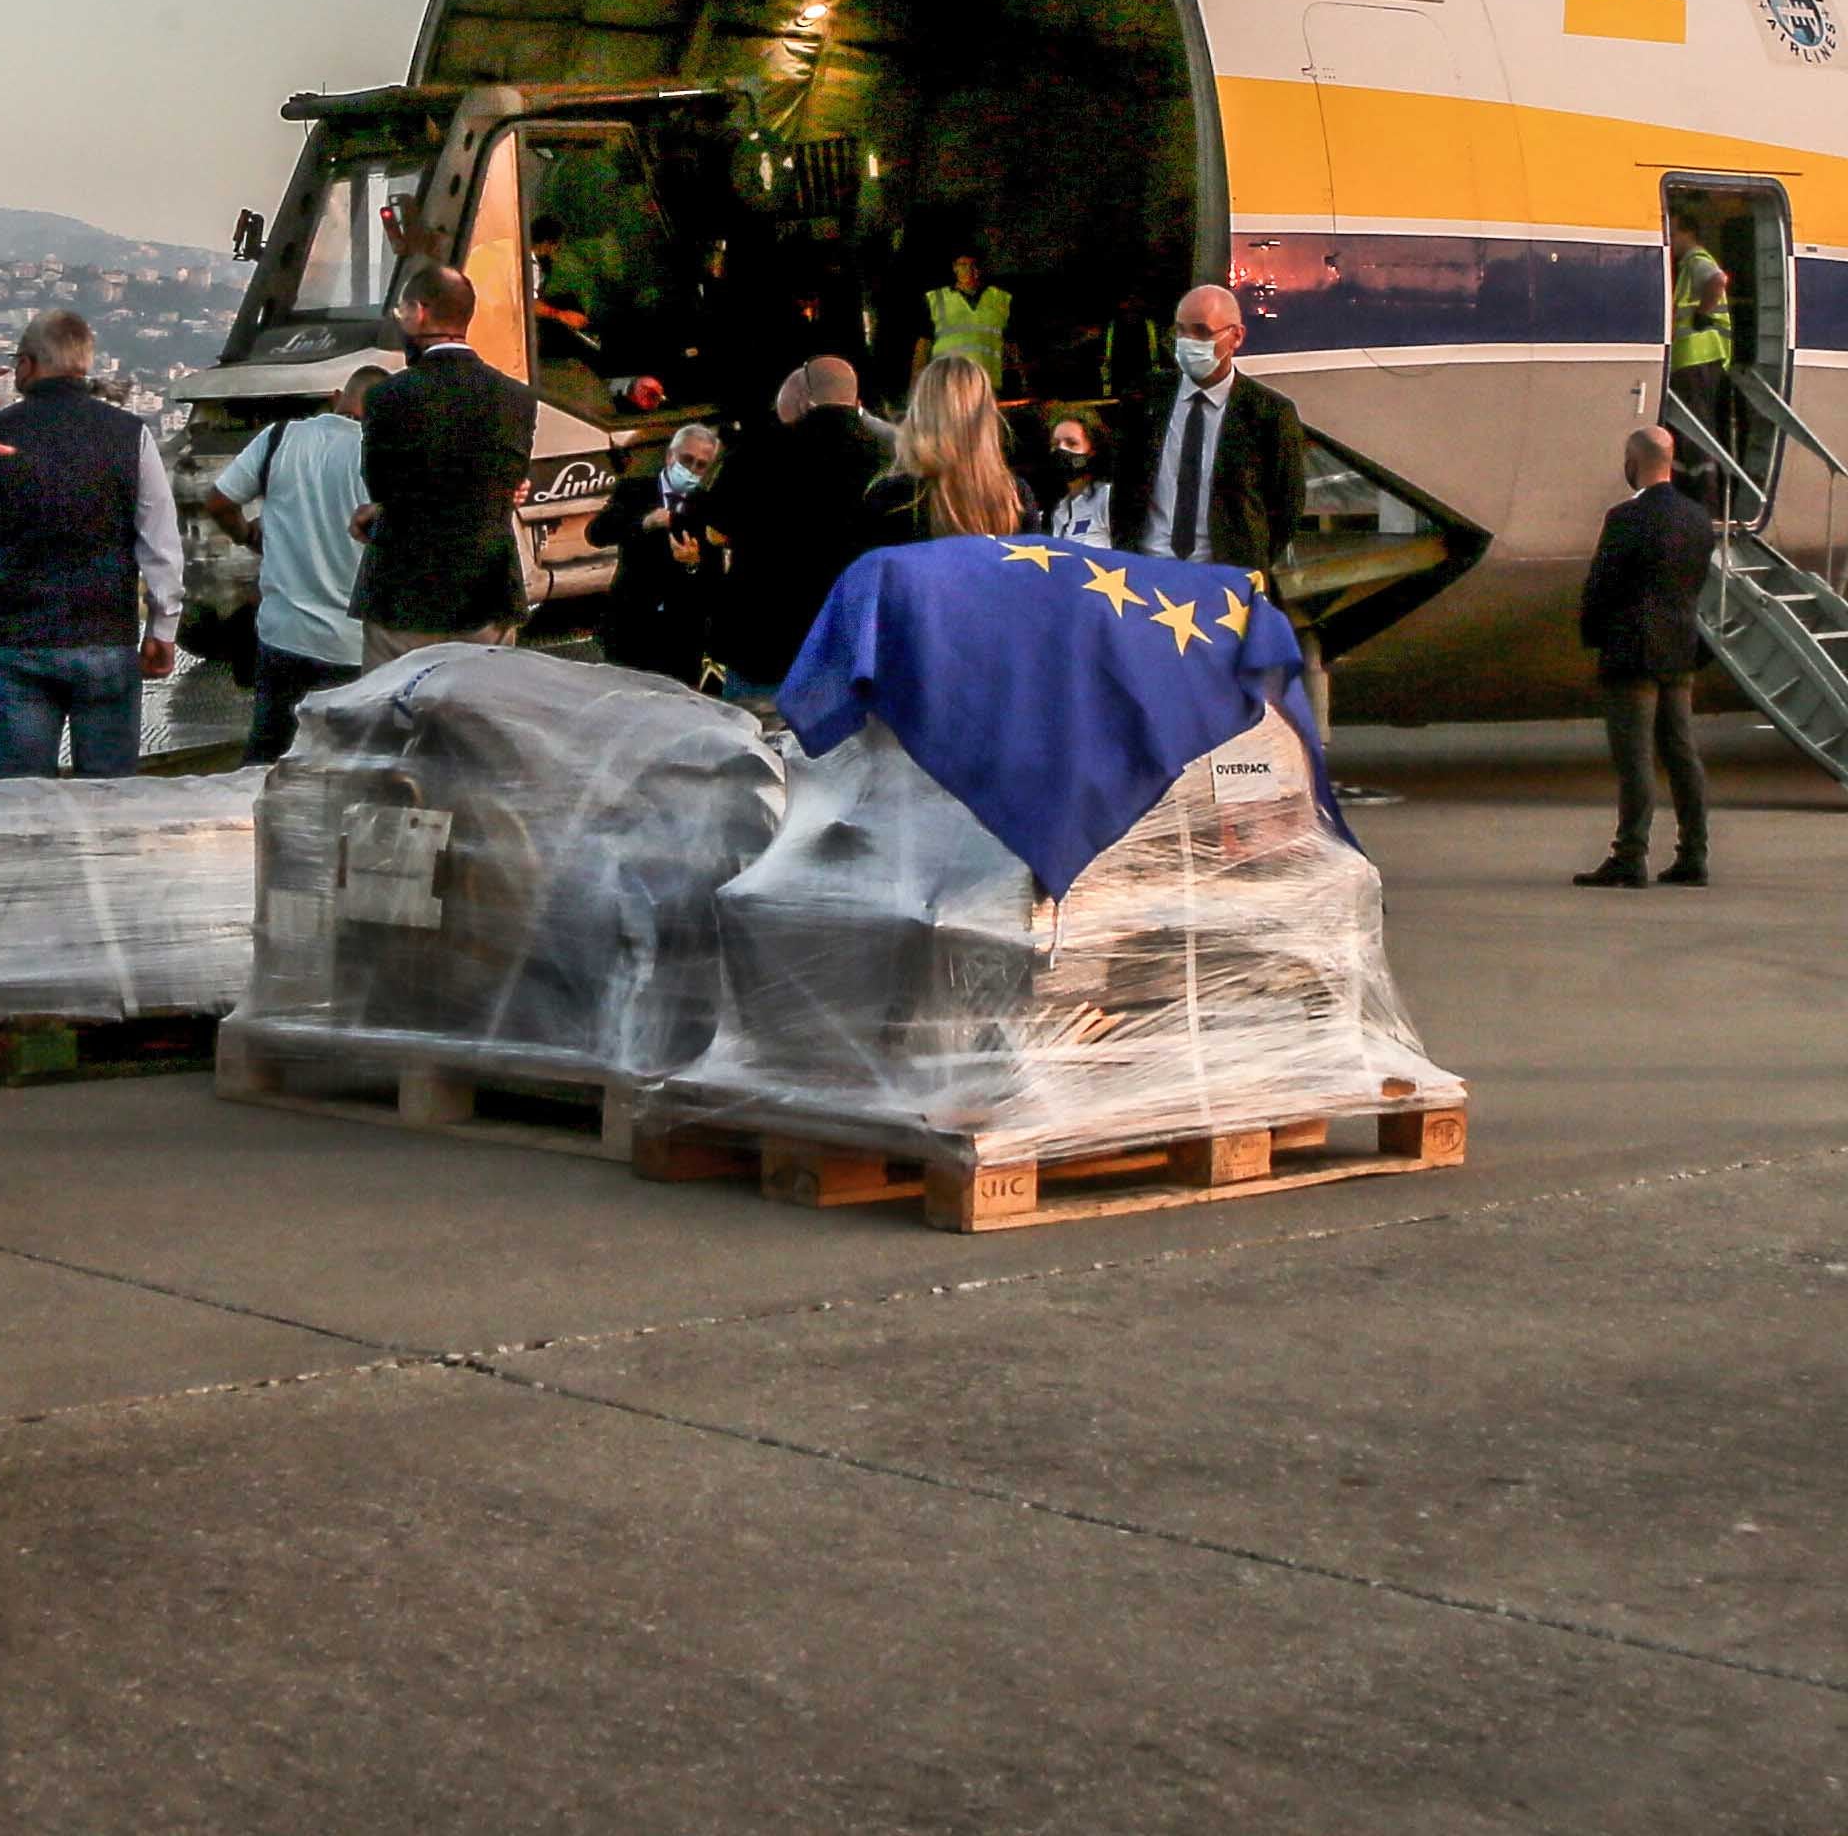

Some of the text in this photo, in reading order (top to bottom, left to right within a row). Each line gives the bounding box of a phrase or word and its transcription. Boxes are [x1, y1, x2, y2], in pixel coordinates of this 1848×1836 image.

[1766, 19, 1836, 64] AIRLINES
[1216, 763, 1272, 775] OVERPACK
[981, 1176, 1025, 1198] UIC
